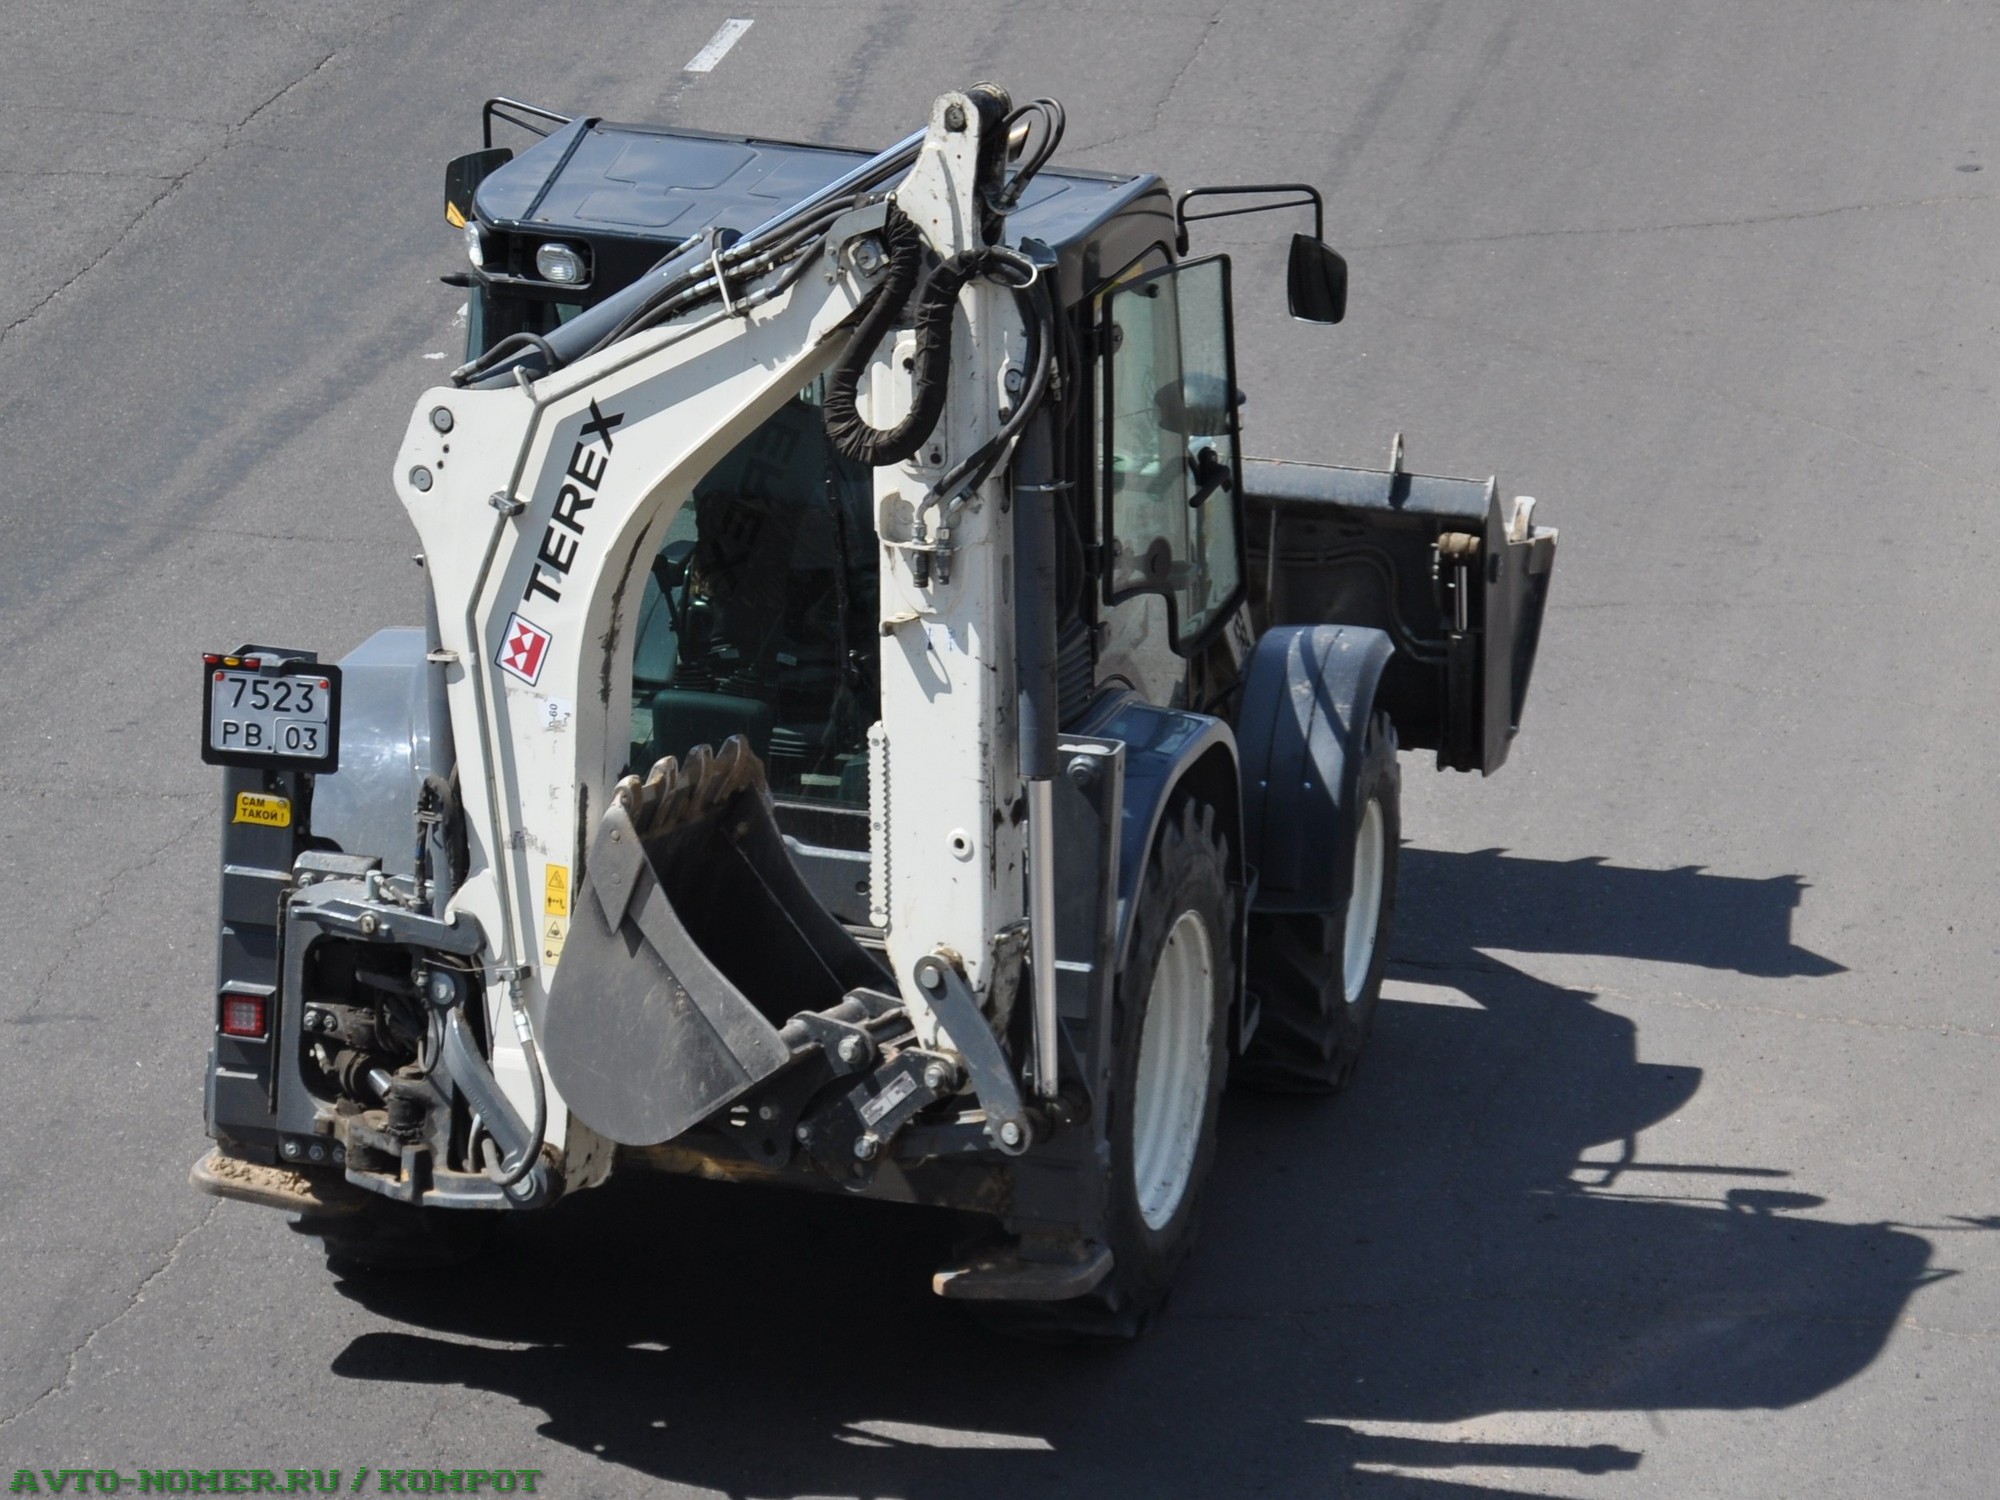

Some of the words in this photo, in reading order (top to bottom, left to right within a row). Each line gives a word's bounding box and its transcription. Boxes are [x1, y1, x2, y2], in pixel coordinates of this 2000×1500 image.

[523, 397, 625, 602] TEREX
[229, 677, 314, 713] 7523
[286, 726, 318, 751] 03
[241, 796, 266, 809] САМ
